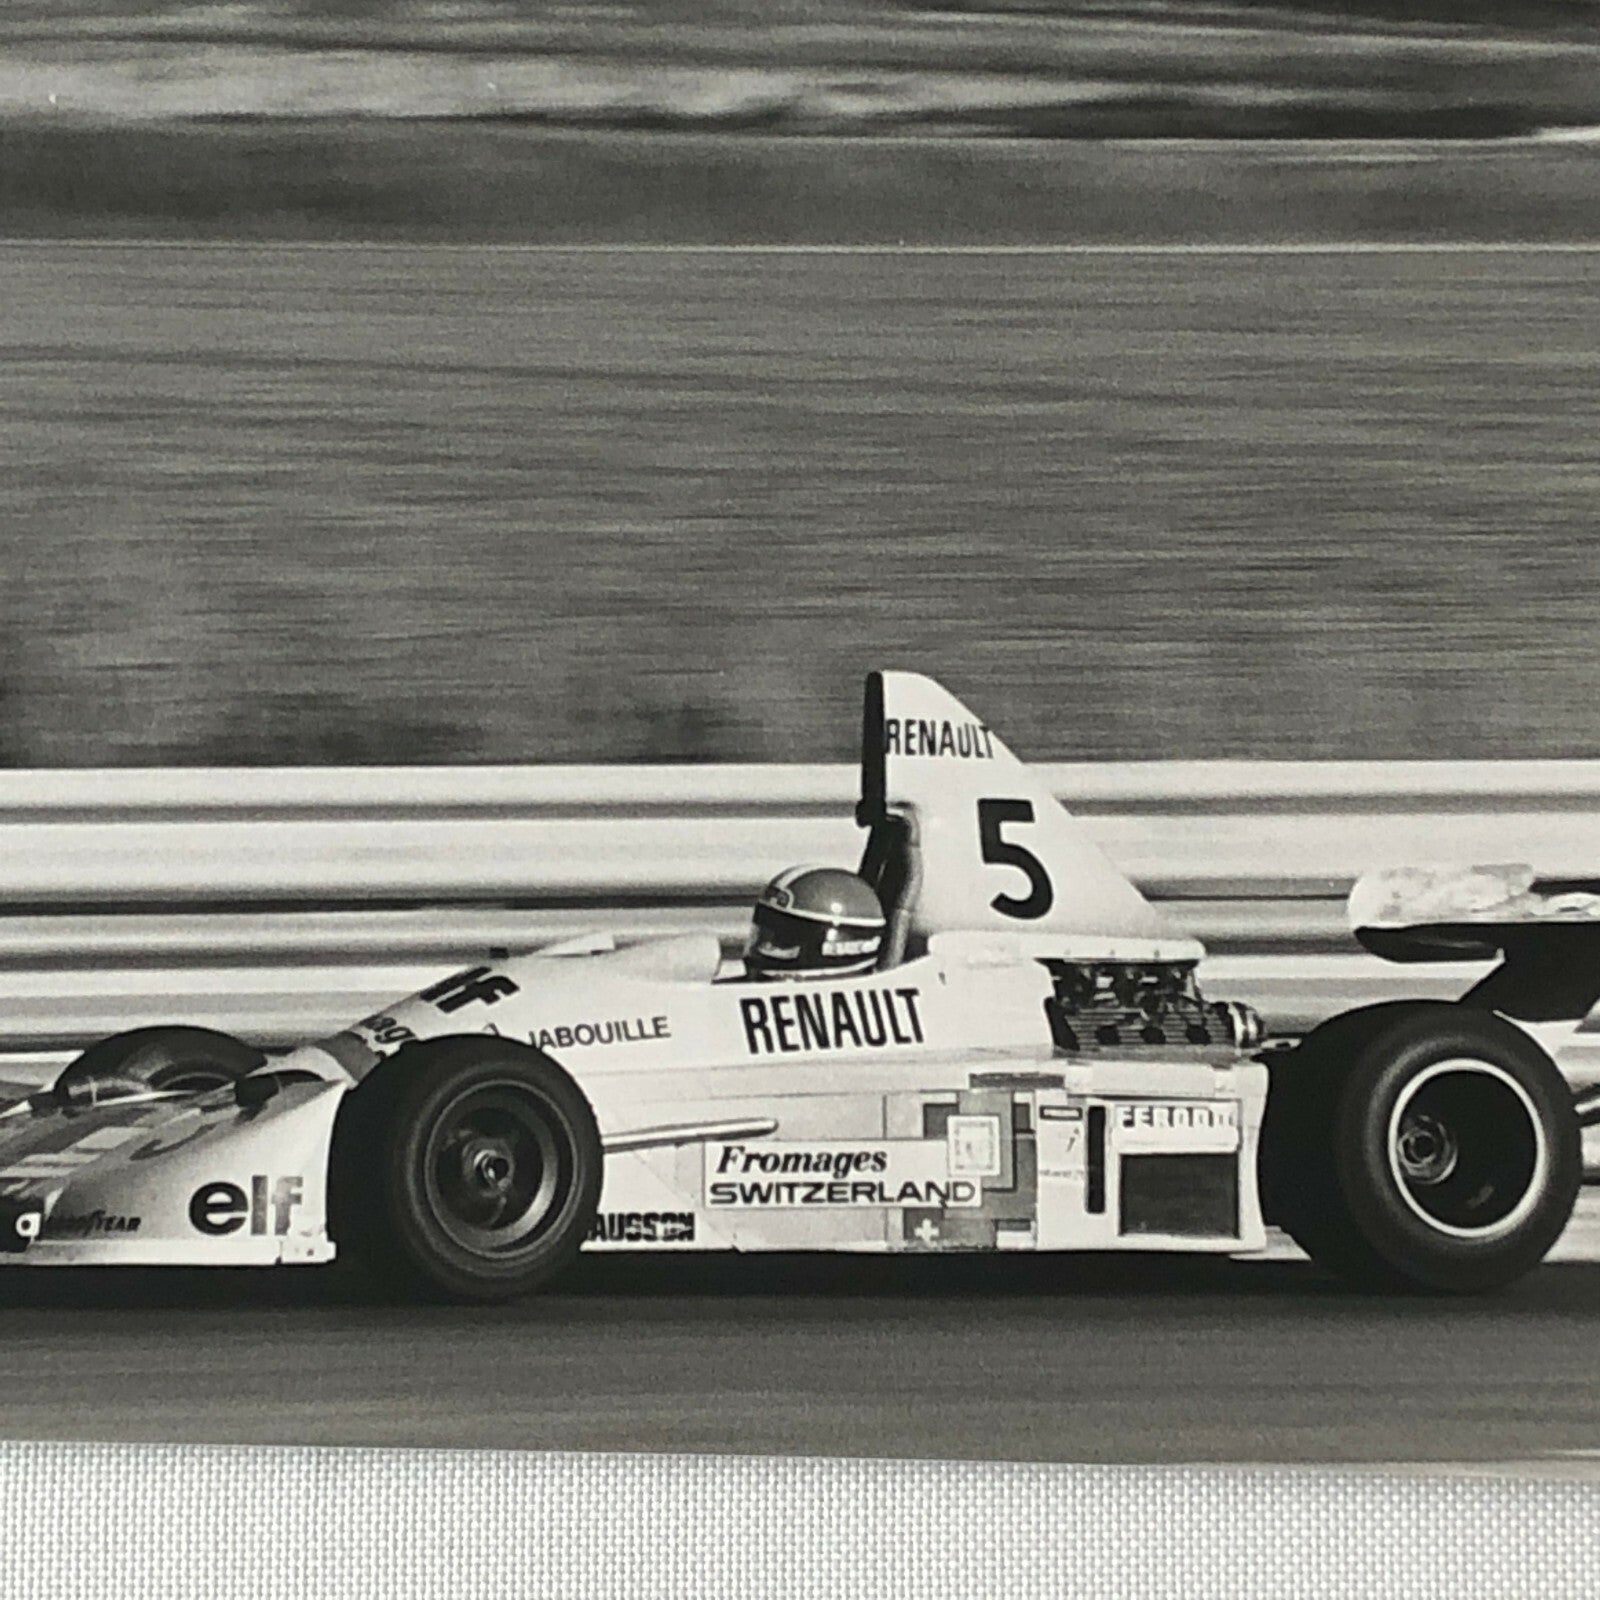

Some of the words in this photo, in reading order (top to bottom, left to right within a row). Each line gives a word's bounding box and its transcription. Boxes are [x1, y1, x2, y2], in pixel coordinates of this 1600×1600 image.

[884, 718, 993, 759] RENAULT
[977, 798, 1055, 920] 5
[740, 988, 925, 1055] RENAULT
[715, 1145, 888, 1179] Fromages
[188, 1174, 304, 1237] elf
[709, 1180, 977, 1205] SWITZERLAND
